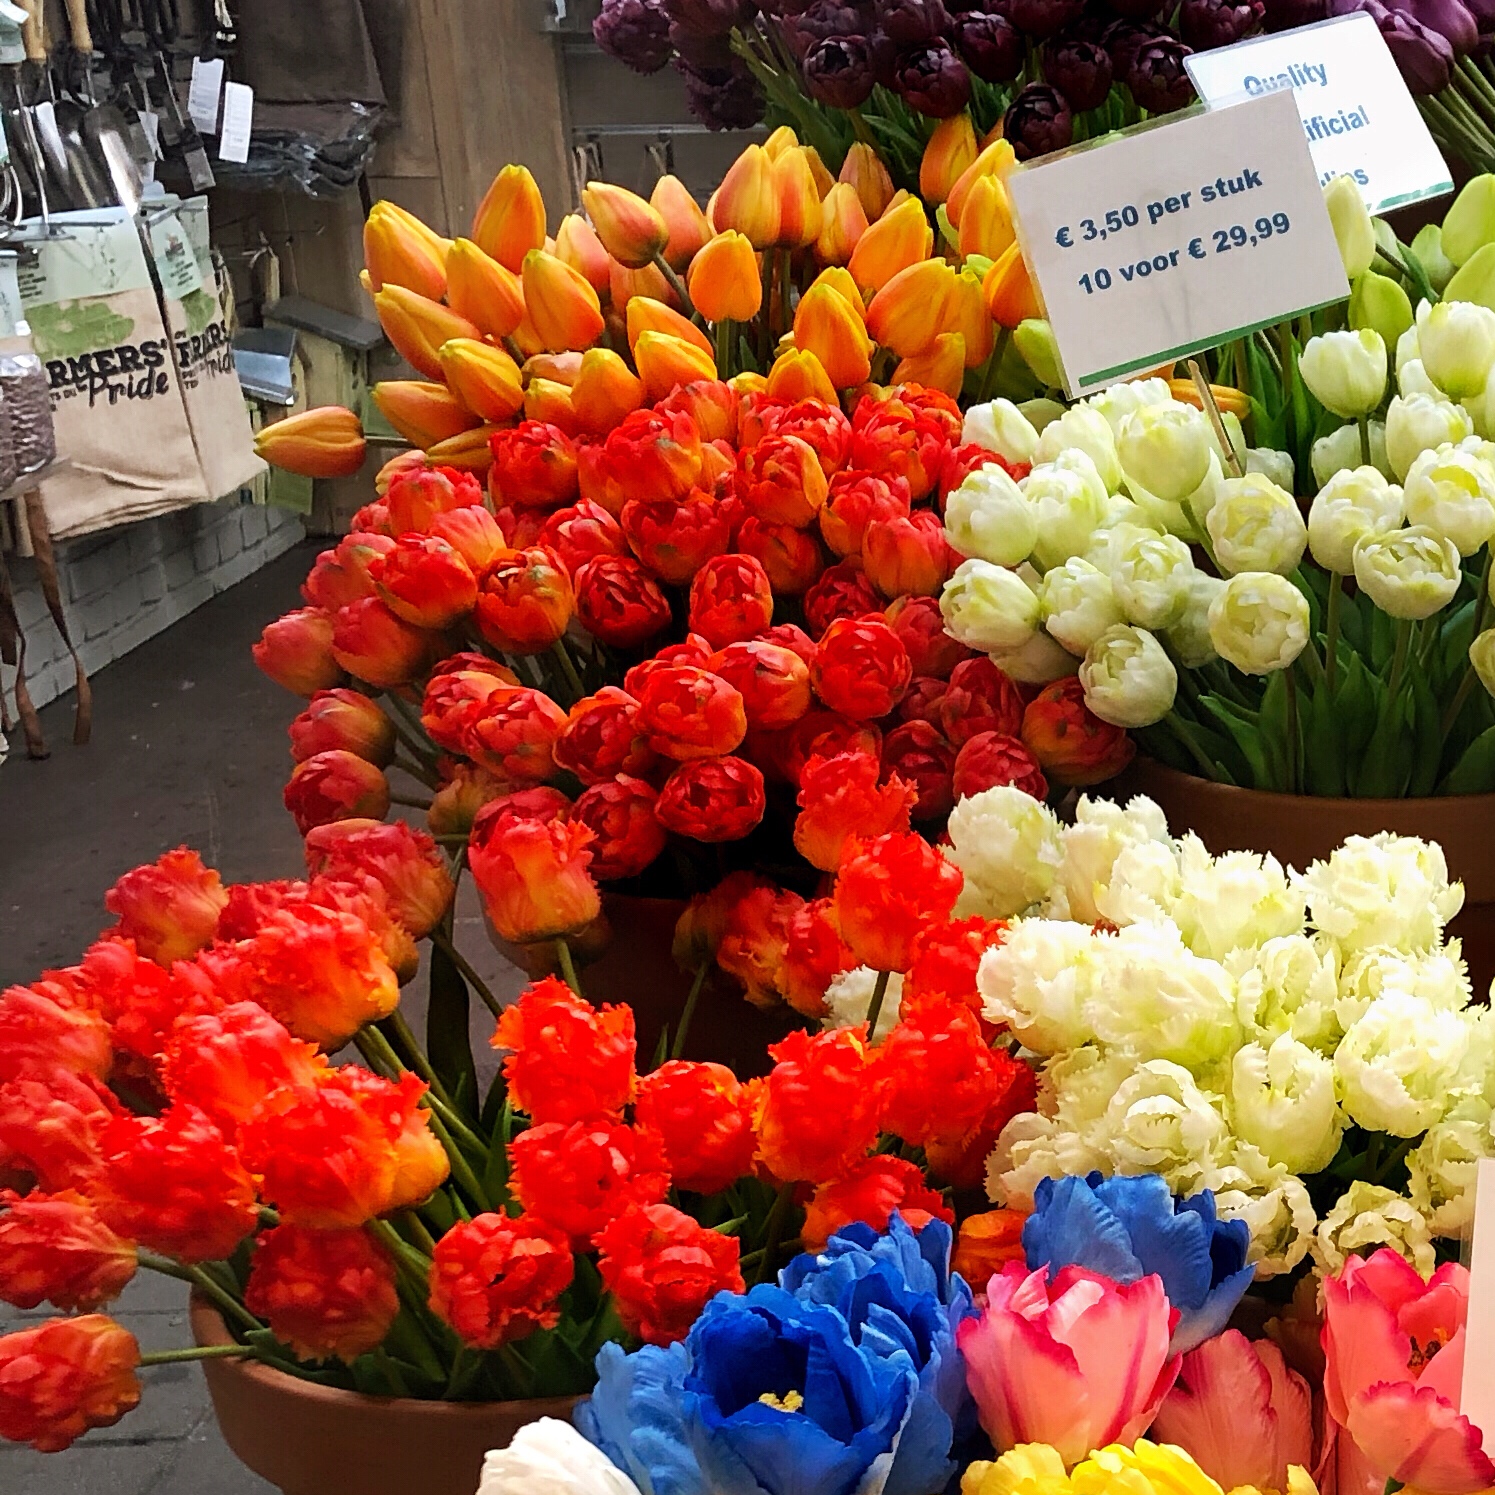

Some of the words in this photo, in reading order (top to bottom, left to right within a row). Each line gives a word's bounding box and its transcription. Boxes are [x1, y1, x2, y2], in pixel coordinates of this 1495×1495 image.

[1243, 62, 1328, 95] Quality
[1303, 104, 1370, 142] ificial
[1055, 226, 1074, 247] €
[1080, 205, 1139, 240] 3,50
[1147, 191, 1191, 224] per
[1200, 168, 1263, 202] stuk
[1078, 268, 1111, 294] 10
[1119, 250, 1179, 281] voor
[1188, 237, 1206, 259] €
[1212, 212, 1290, 252] 29,99
[45, 338, 168, 390] RMERS'
[80, 366, 169, 408] Pride
